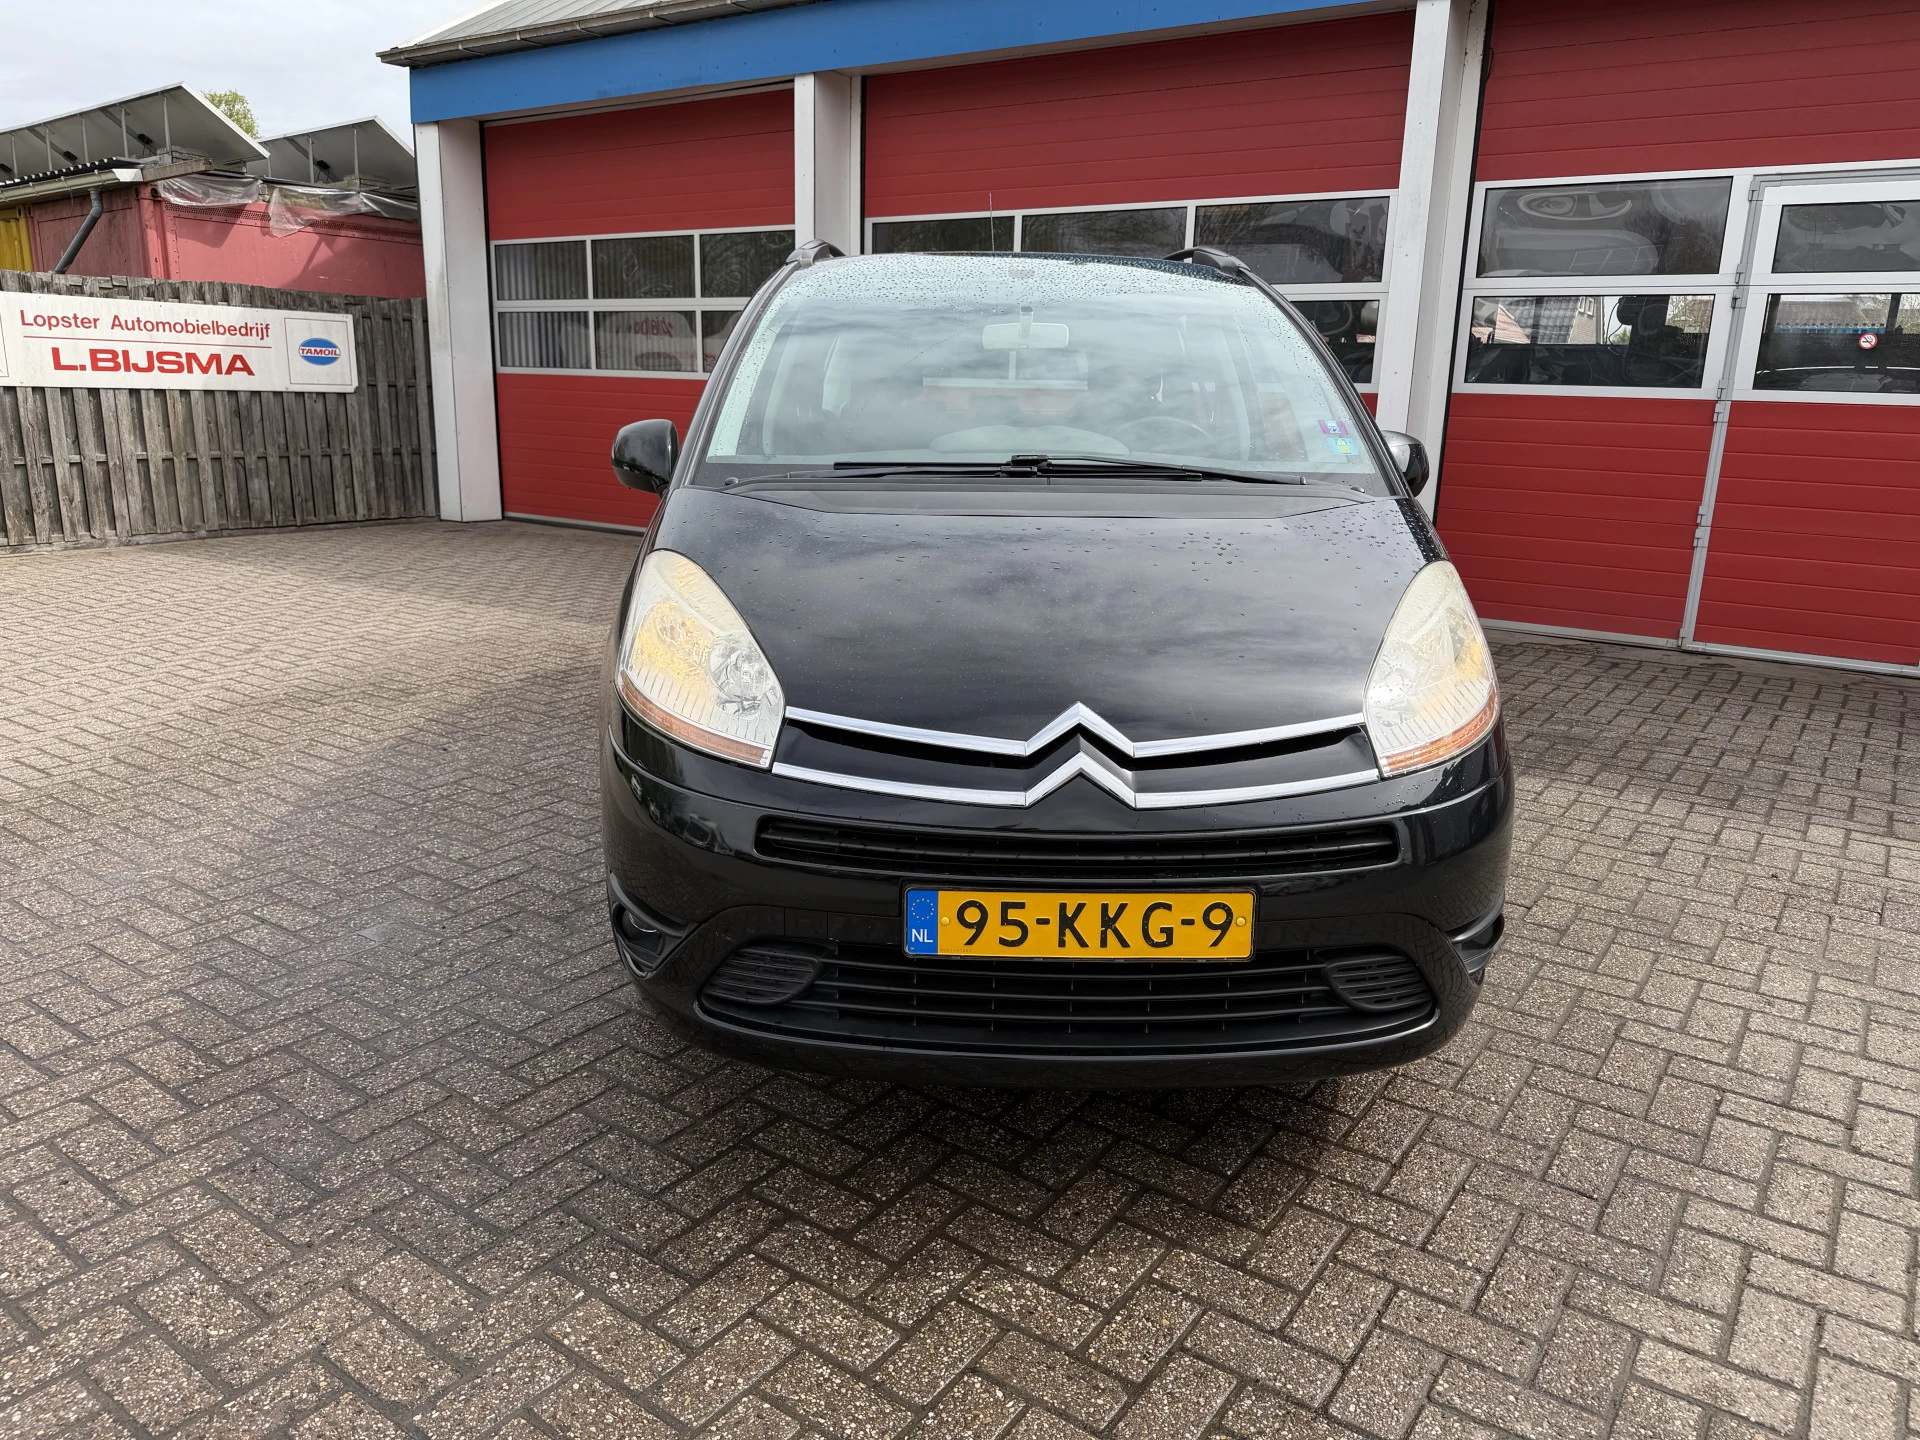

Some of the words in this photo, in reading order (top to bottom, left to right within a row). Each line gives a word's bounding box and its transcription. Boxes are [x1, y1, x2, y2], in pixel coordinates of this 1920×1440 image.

[20, 309, 99, 330] Lopster
[111, 315, 270, 340] Automobielbedrijf
[51, 347, 255, 376] L.BIJSMA
[301, 348, 339, 356] TAMOIL
[911, 928, 934, 943] NL
[956, 900, 1234, 948] 95-KKG-9
